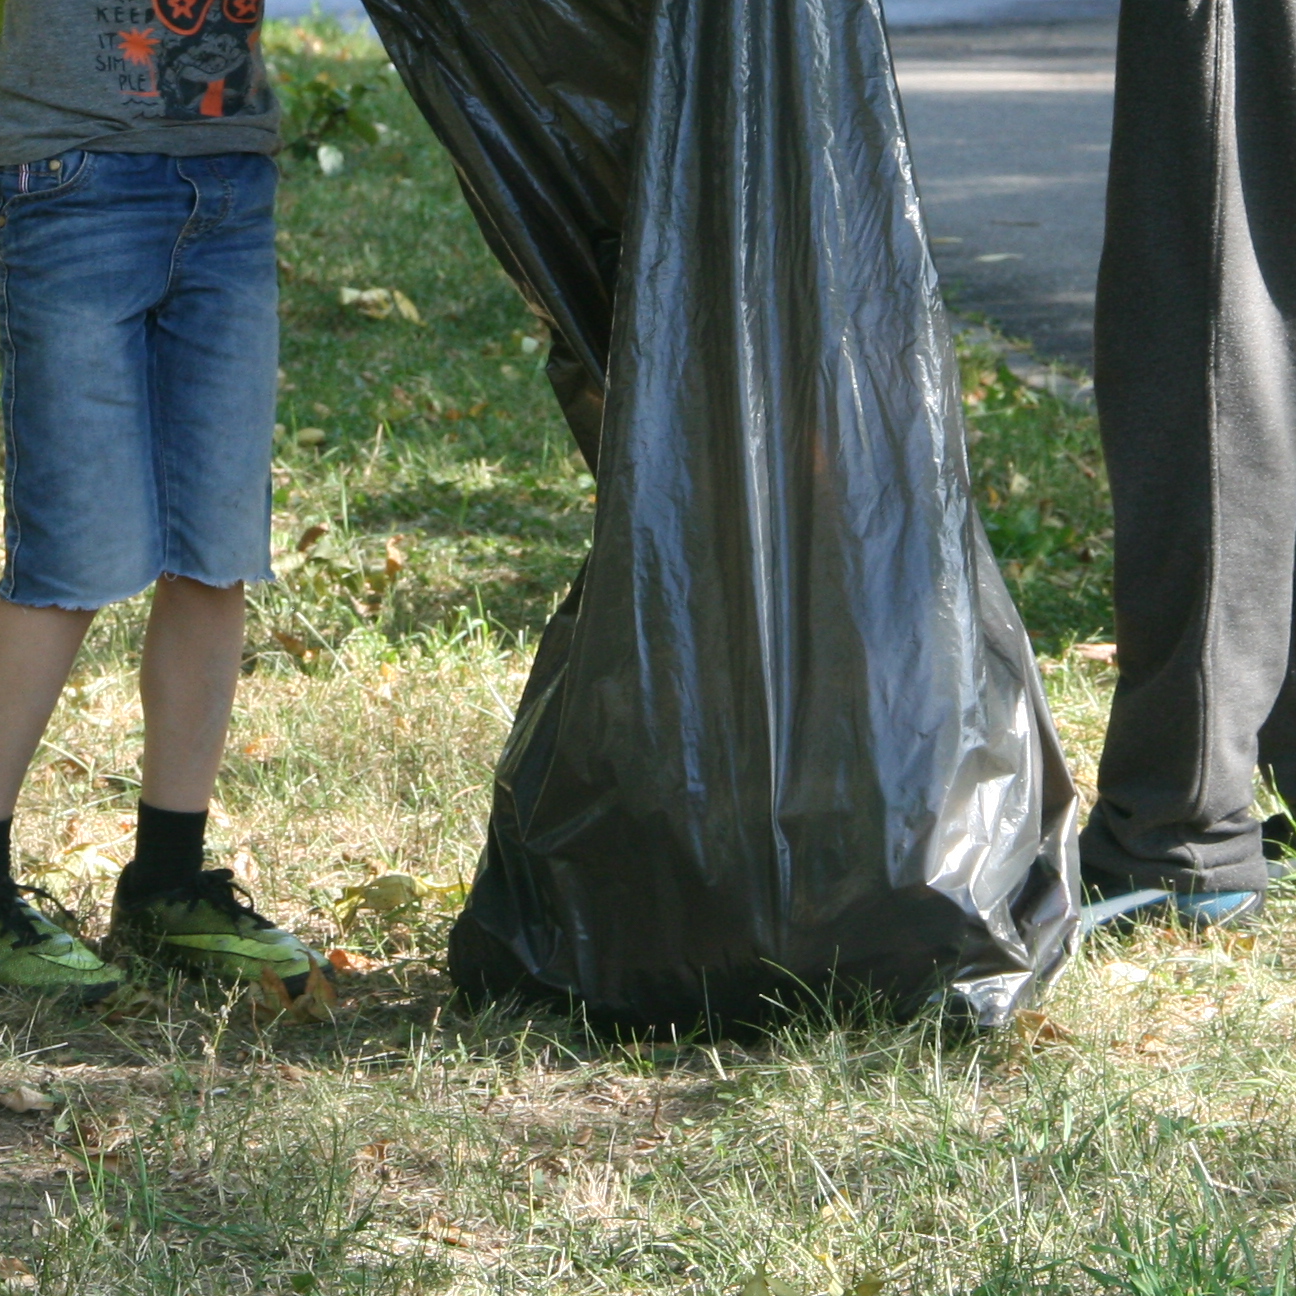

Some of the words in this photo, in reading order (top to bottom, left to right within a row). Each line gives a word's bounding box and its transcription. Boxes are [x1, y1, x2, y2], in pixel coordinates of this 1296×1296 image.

[98, 31, 118, 50] IT
[95, 54, 126, 72] SIM
[119, 73, 147, 92] PLE
